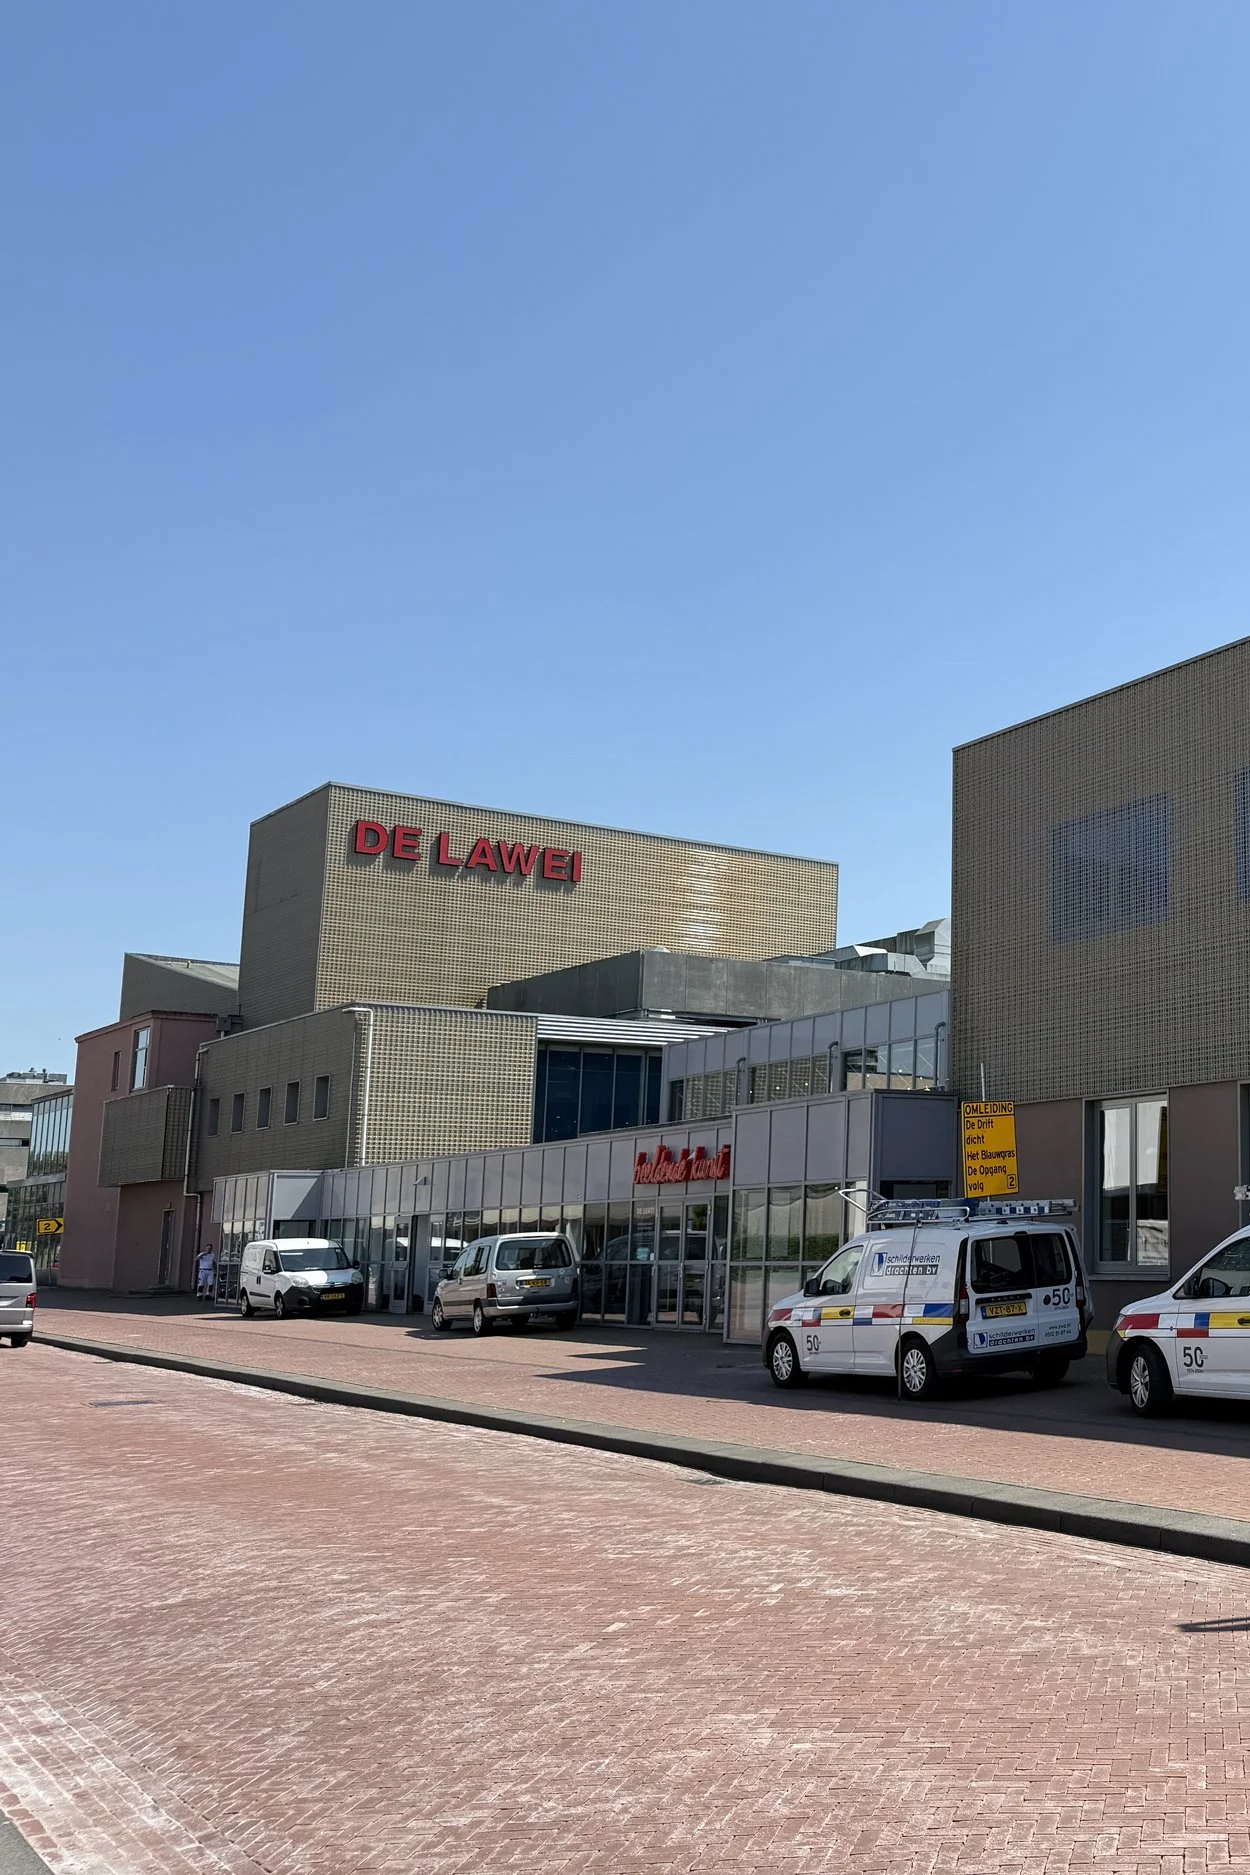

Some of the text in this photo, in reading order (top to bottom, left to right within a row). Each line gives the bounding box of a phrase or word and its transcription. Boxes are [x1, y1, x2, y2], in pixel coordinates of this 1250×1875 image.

[355, 820, 582, 882] DE LAWEI
[965, 1103, 1013, 1115] OMLEIDING
[965, 1118, 994, 1130] De Drift
[966, 1134, 985, 1145] dicht
[967, 1150, 1015, 1161] Het Blauwgras
[967, 1164, 1007, 1177] De Opgang
[968, 1181, 984, 1192] volg
[1008, 1176, 1015, 1187] 2
[43, 1222, 51, 1231] 2
[886, 1254, 941, 1264] schilderwerken
[886, 1265, 937, 1275] drachten bv
[1052, 1287, 1071, 1306] 50
[989, 1305, 1023, 1316] VZT-87-X
[988, 1328, 1036, 1339] schilderwerken
[806, 1335, 819, 1351] 50
[990, 1336, 1024, 1346] drachten
[1183, 1346, 1204, 1367] 50
